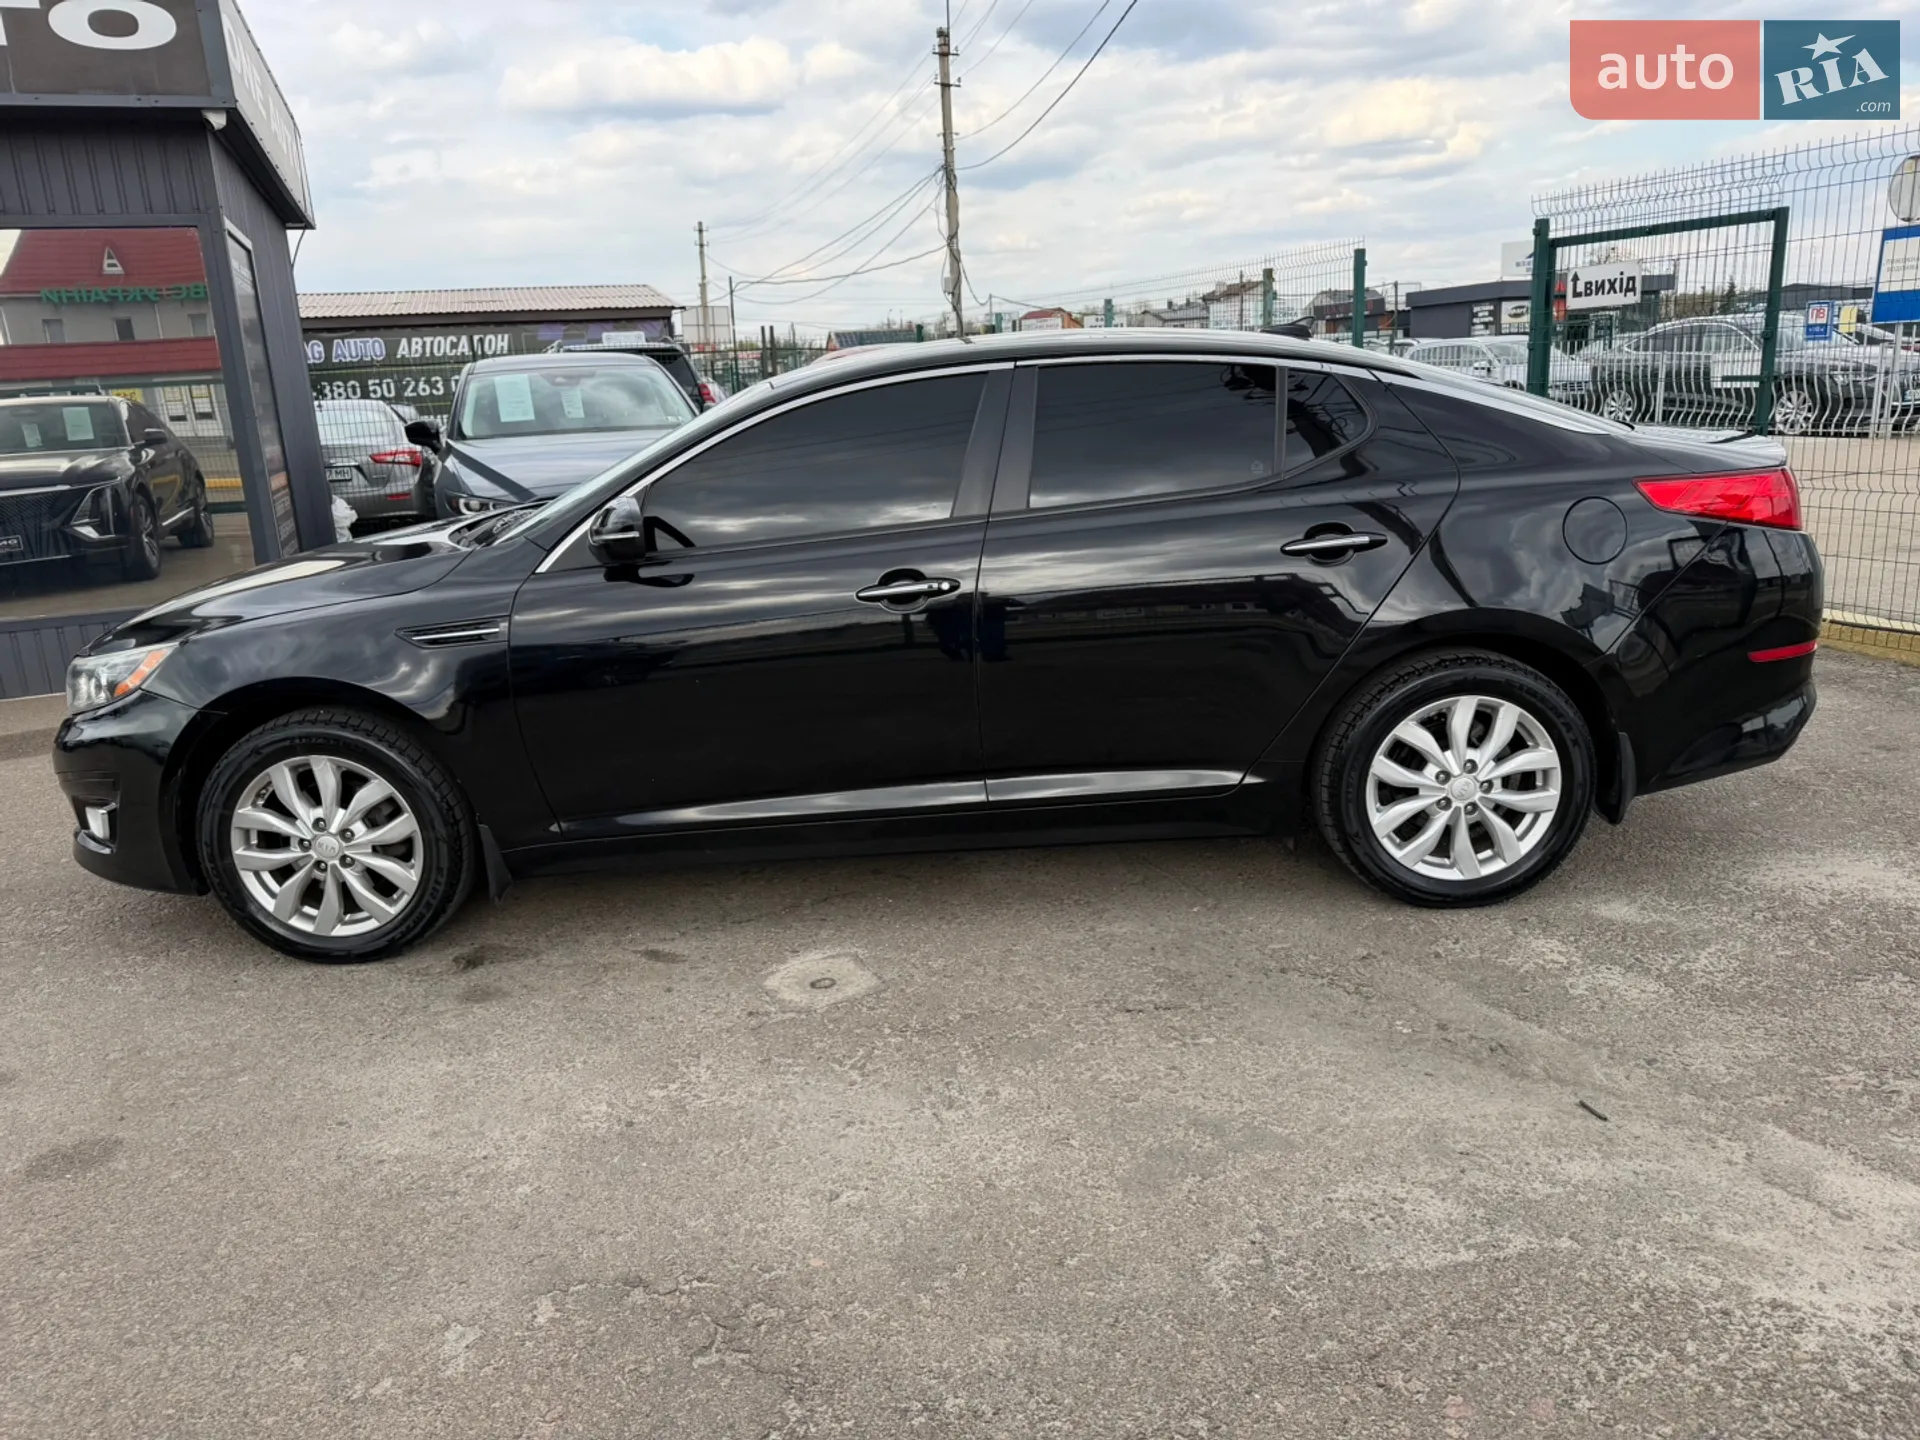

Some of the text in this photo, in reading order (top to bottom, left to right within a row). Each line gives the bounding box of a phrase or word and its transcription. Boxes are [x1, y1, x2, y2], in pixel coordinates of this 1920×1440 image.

[332, 337, 386, 363] AUTO
[368, 378, 396, 399] 50
[402, 376, 444, 397] 263
[317, 841, 337, 853] KIA
